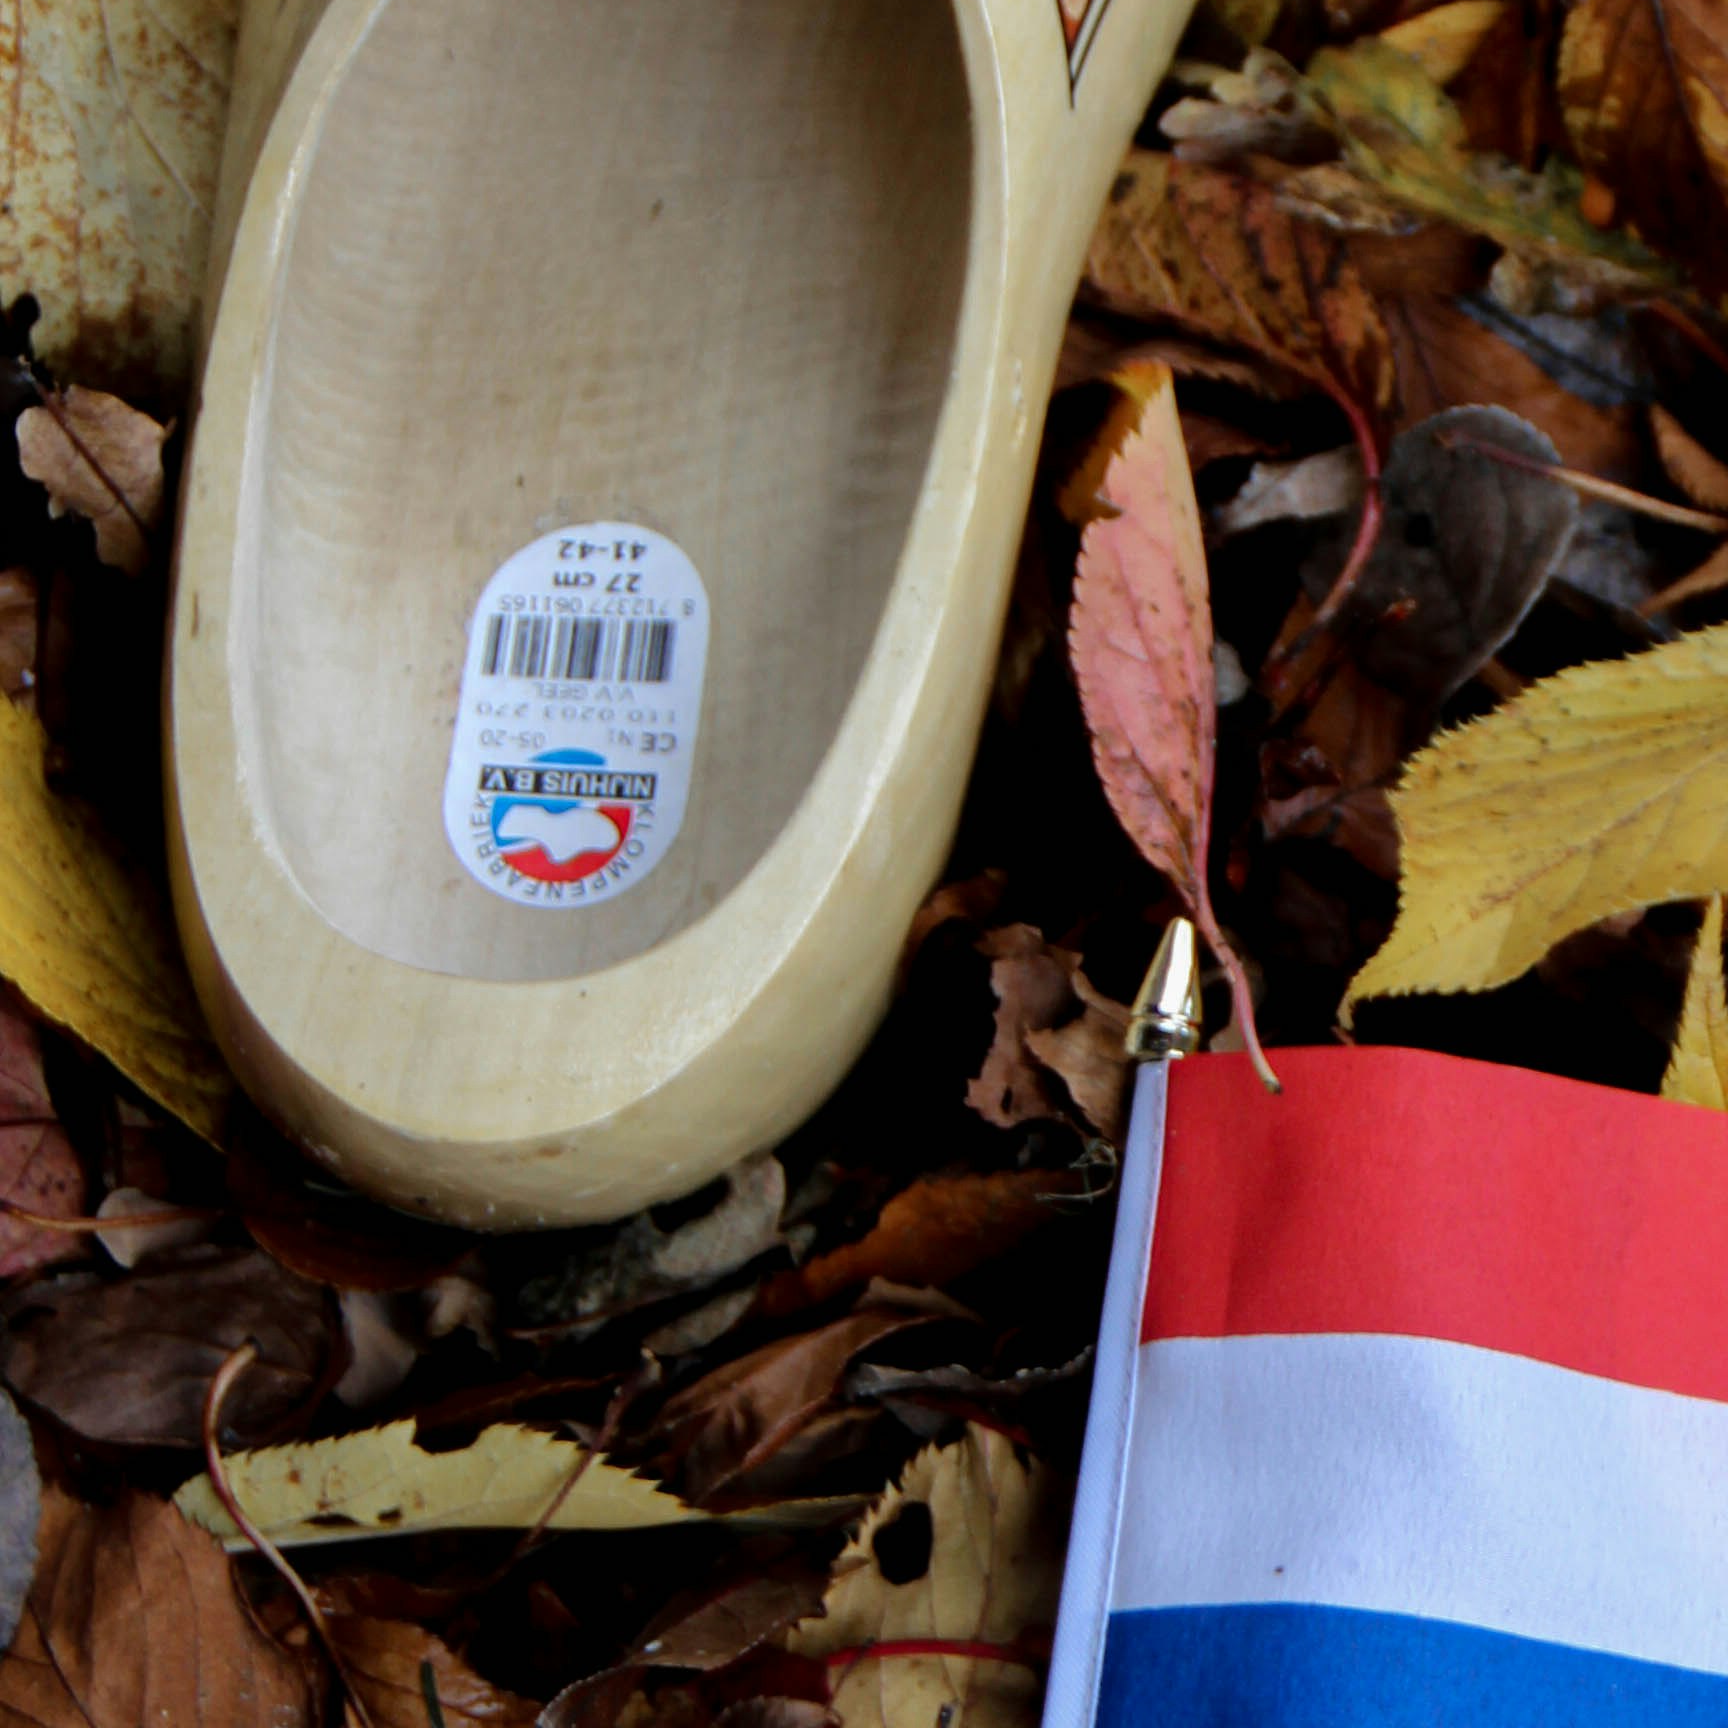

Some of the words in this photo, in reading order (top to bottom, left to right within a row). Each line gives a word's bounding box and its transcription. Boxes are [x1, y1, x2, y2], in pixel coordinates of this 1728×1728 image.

[558, 540, 646, 560] 41-42
[552, 572, 596, 589] cm
[606, 574, 642, 592] 27
[642, 733, 676, 754] CE
[481, 766, 534, 792] B.V.
[542, 770, 652, 795] NIJHUIS
[469, 796, 655, 900] KLOMPENFABRIEK
